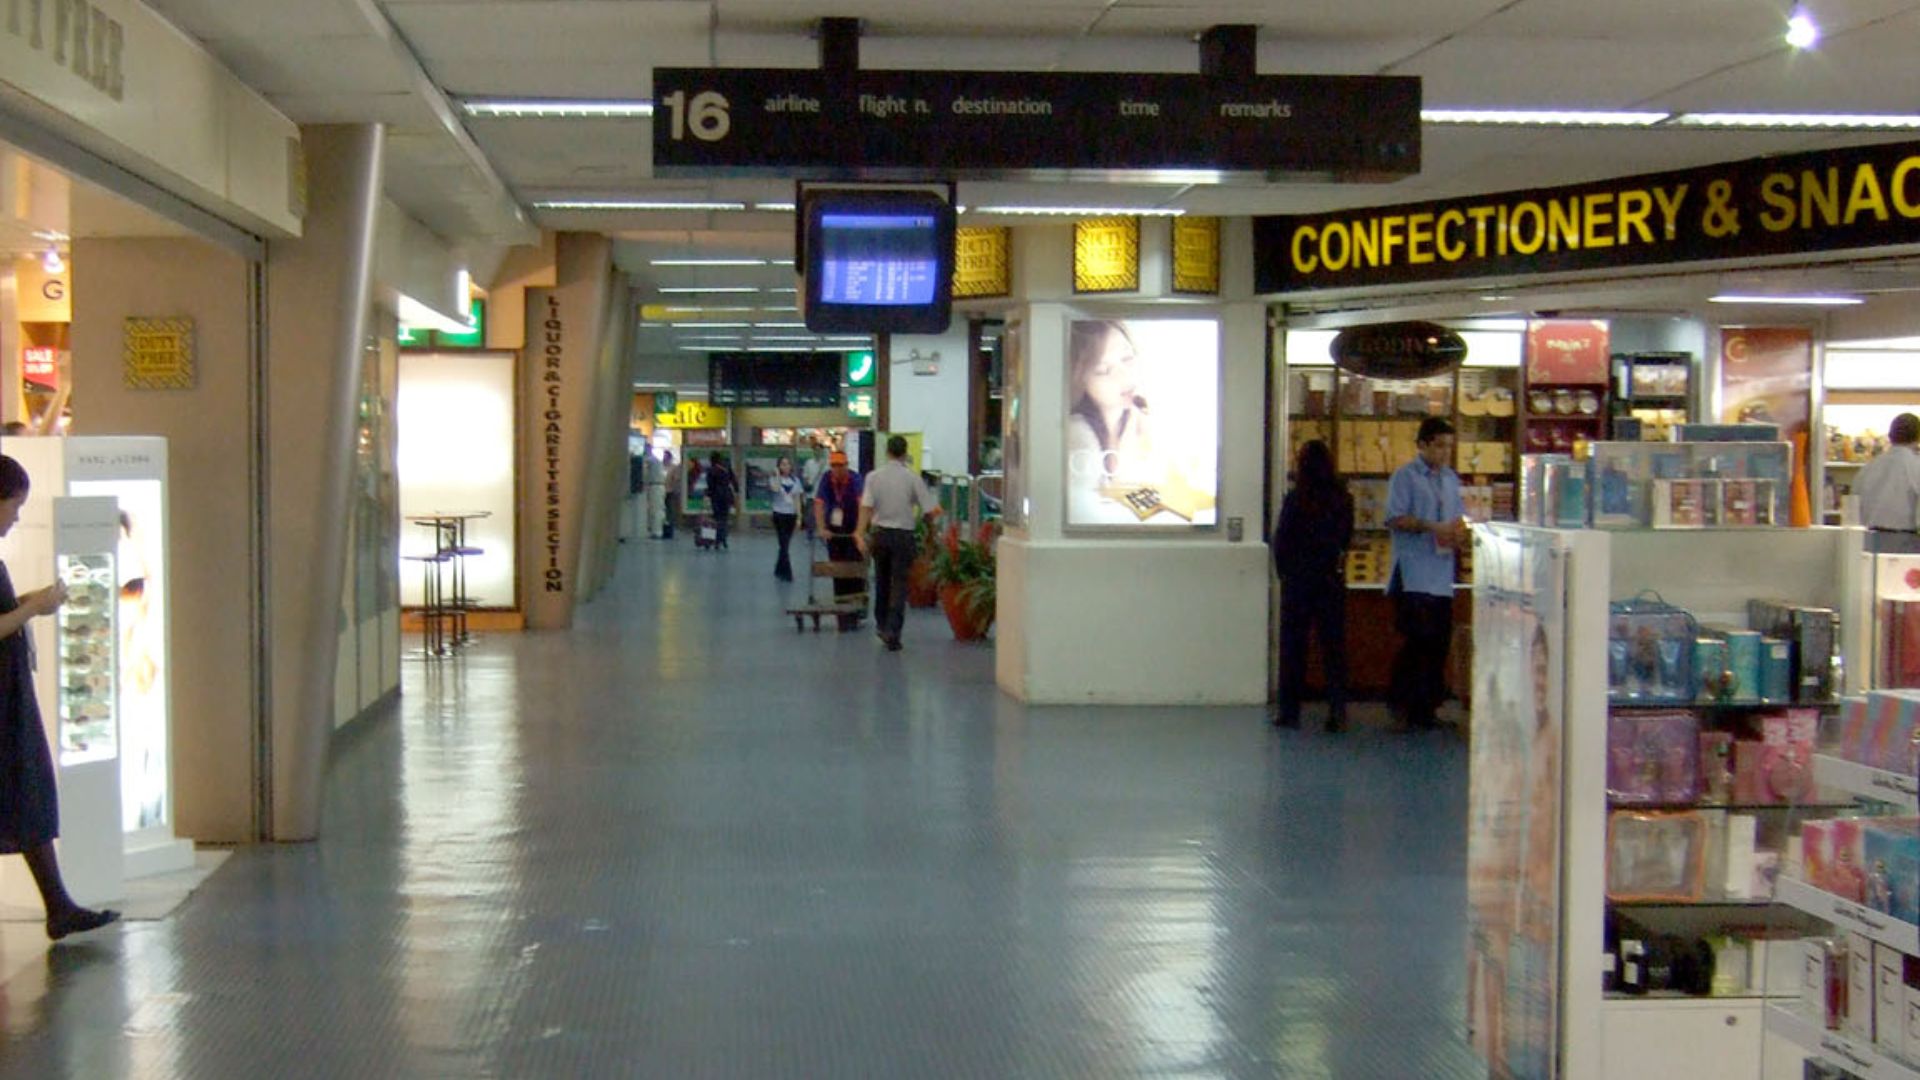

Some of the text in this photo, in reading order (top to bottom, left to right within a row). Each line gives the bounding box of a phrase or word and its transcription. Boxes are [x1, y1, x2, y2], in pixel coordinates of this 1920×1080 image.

[663, 90, 731, 142] 16
[764, 94, 1292, 119] airline flight n. destination time remarks
[1291, 156, 1920, 273] CONFECTIONERY & SNAC
[42, 279, 64, 301] G
[544, 296, 562, 368] LIQUOR
[545, 386, 562, 505] CIGARETTES
[546, 508, 562, 592] SECTION
